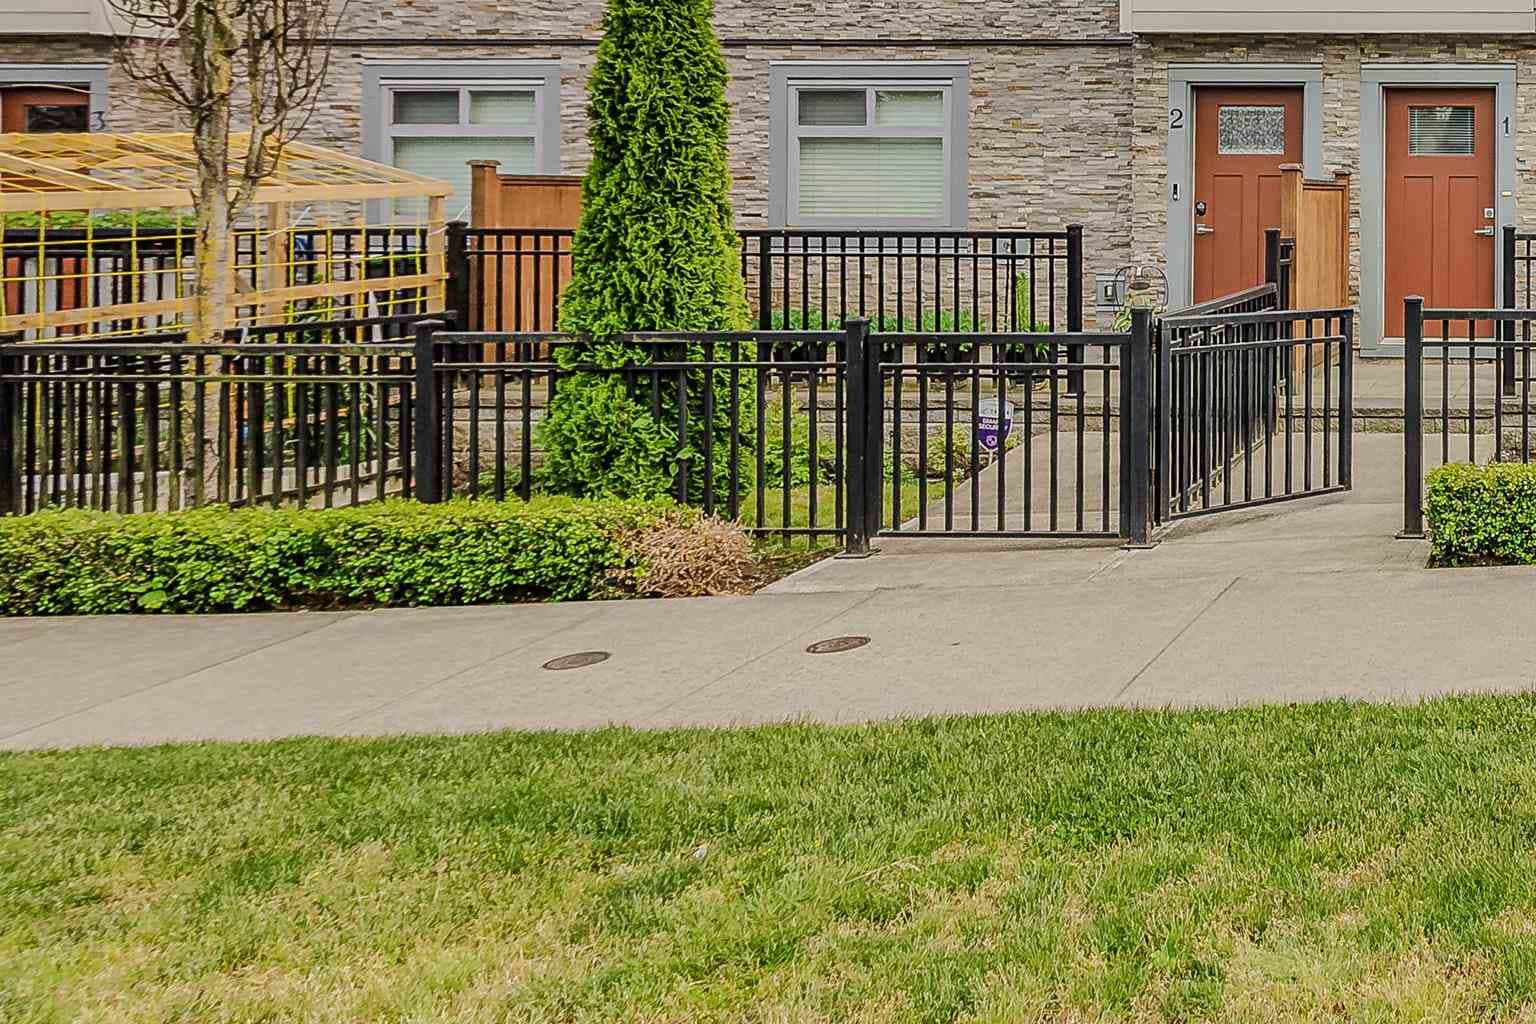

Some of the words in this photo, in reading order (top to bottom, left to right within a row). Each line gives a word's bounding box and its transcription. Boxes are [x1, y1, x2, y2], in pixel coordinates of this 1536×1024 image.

[91, 110, 106, 131] 3
[1170, 108, 1183, 129] 2
[1502, 116, 1509, 134] 1
